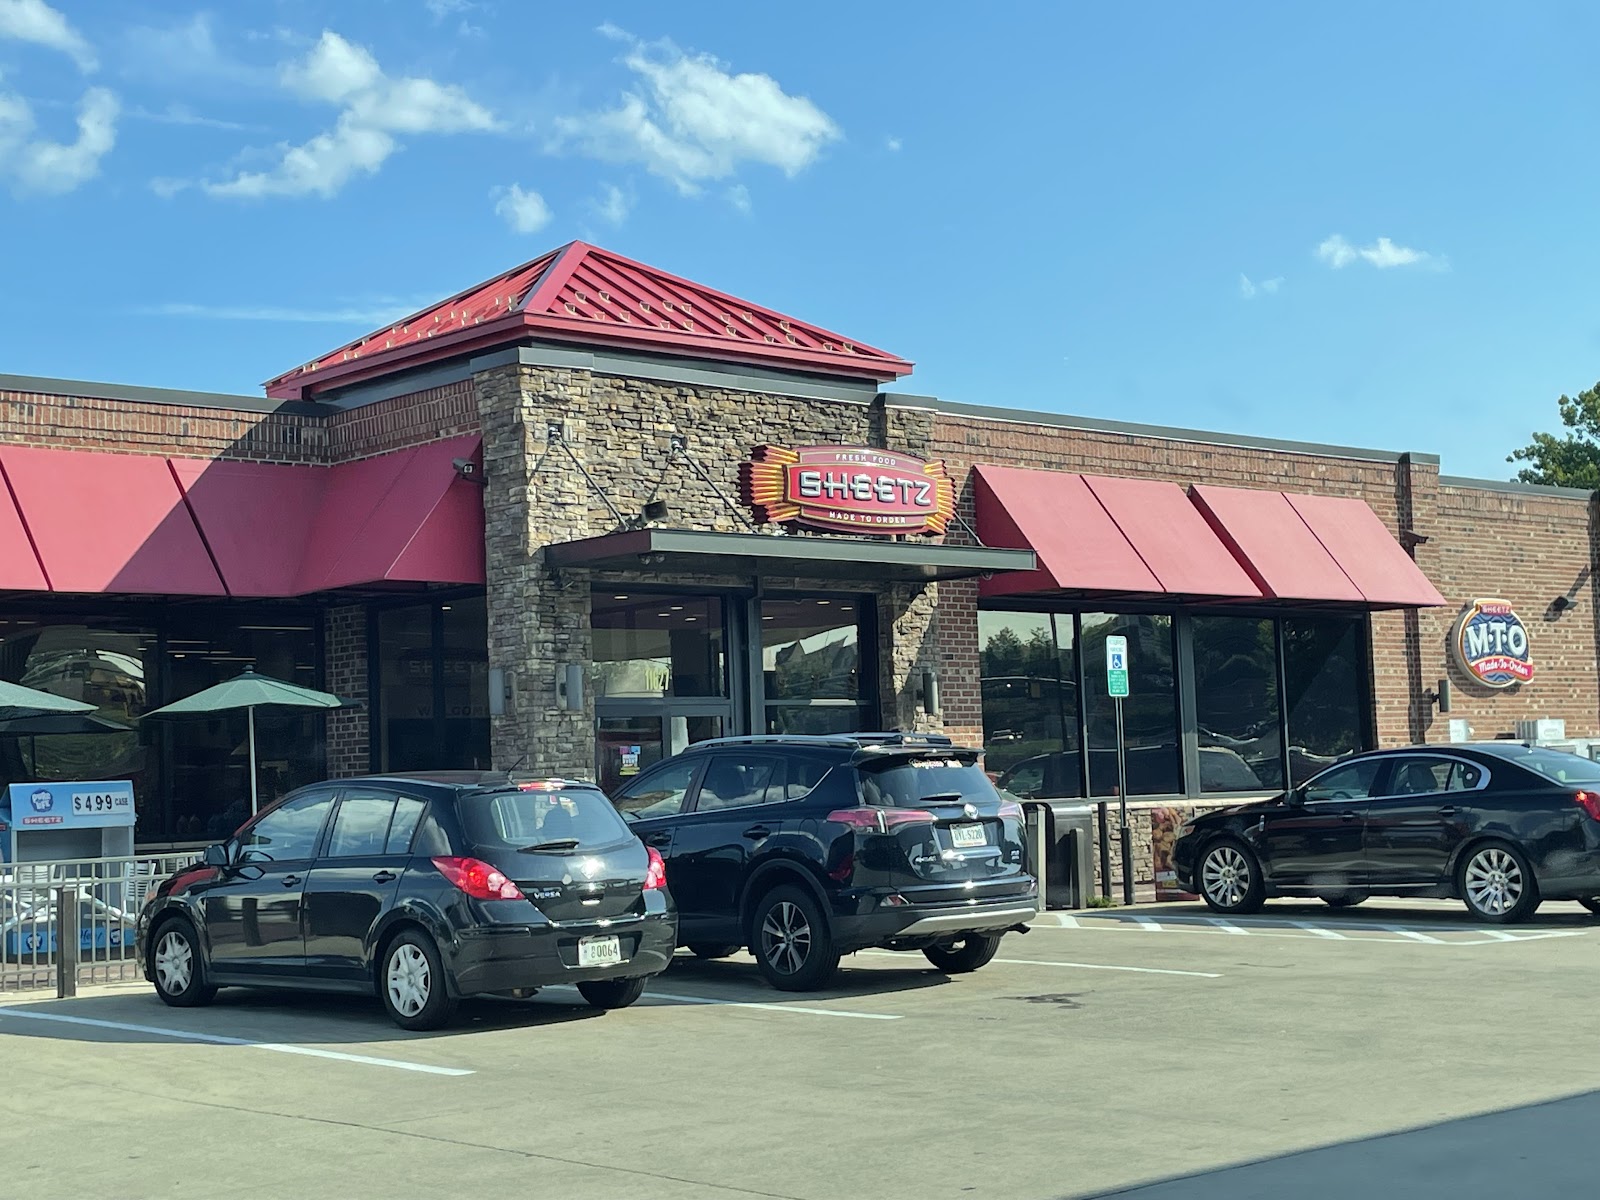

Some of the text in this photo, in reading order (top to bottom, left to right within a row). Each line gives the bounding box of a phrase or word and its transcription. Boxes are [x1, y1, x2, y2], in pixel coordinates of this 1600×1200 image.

[835, 453, 896, 465] FRESH FOOD
[799, 471, 932, 506] SHEETZ
[829, 511, 906, 524] MADE TO ORDER
[24, 816, 62, 825] SHEETZ
